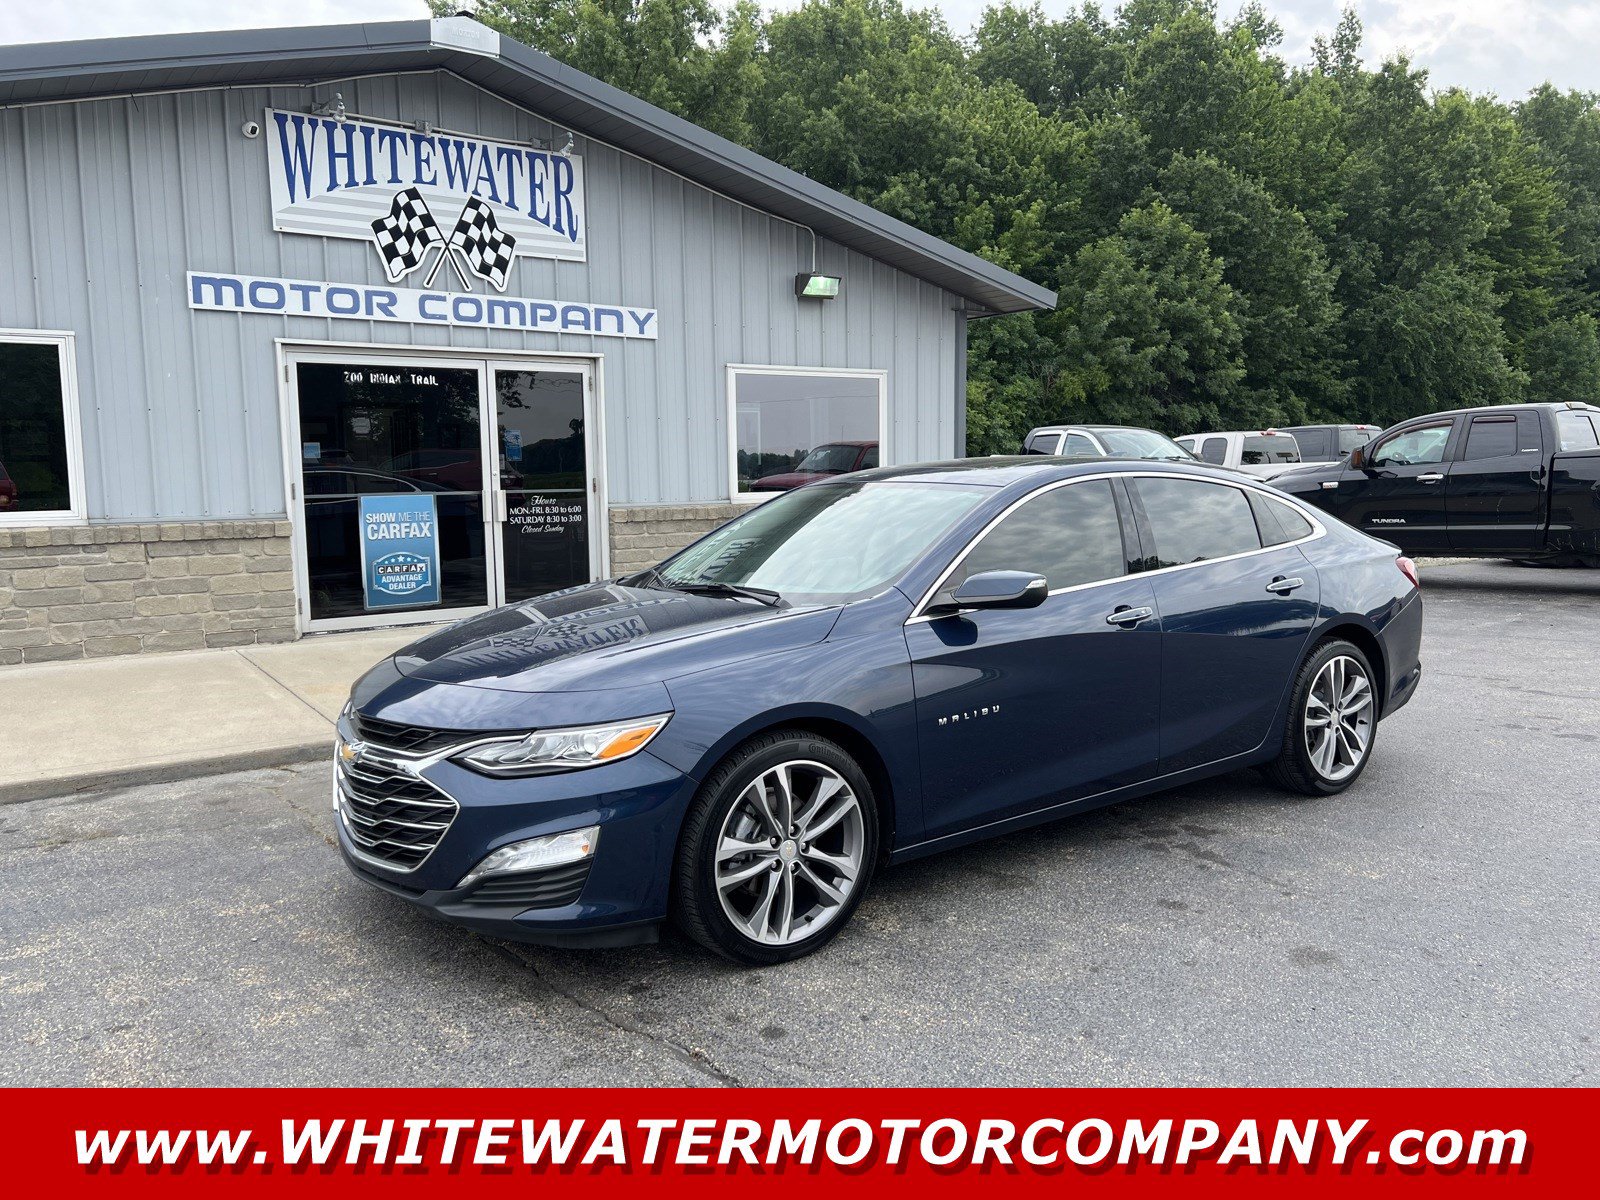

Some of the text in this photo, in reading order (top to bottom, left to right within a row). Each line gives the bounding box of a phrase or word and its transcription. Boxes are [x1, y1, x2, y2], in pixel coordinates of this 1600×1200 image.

[273, 112, 579, 244] WHITEWATER
[192, 274, 656, 335] MOTOR COMPANY
[410, 374, 439, 386] TRAIL
[531, 495, 557, 506] Hours
[545, 506, 559, 514] 8:30
[568, 505, 582, 513] 6:00
[365, 511, 431, 524] SHOW ME THE
[509, 515, 545, 525] SATURDAY
[546, 515, 560, 523] 8:30
[569, 514, 582, 522] 3:00
[367, 522, 432, 541] CARFAX
[521, 524, 564, 534] Closed Sunday
[377, 563, 427, 575] CARFAX
[381, 574, 423, 583] ADVANTAGE
[388, 581, 417, 591] DEALER
[938, 704, 1000, 726] MALIBU
